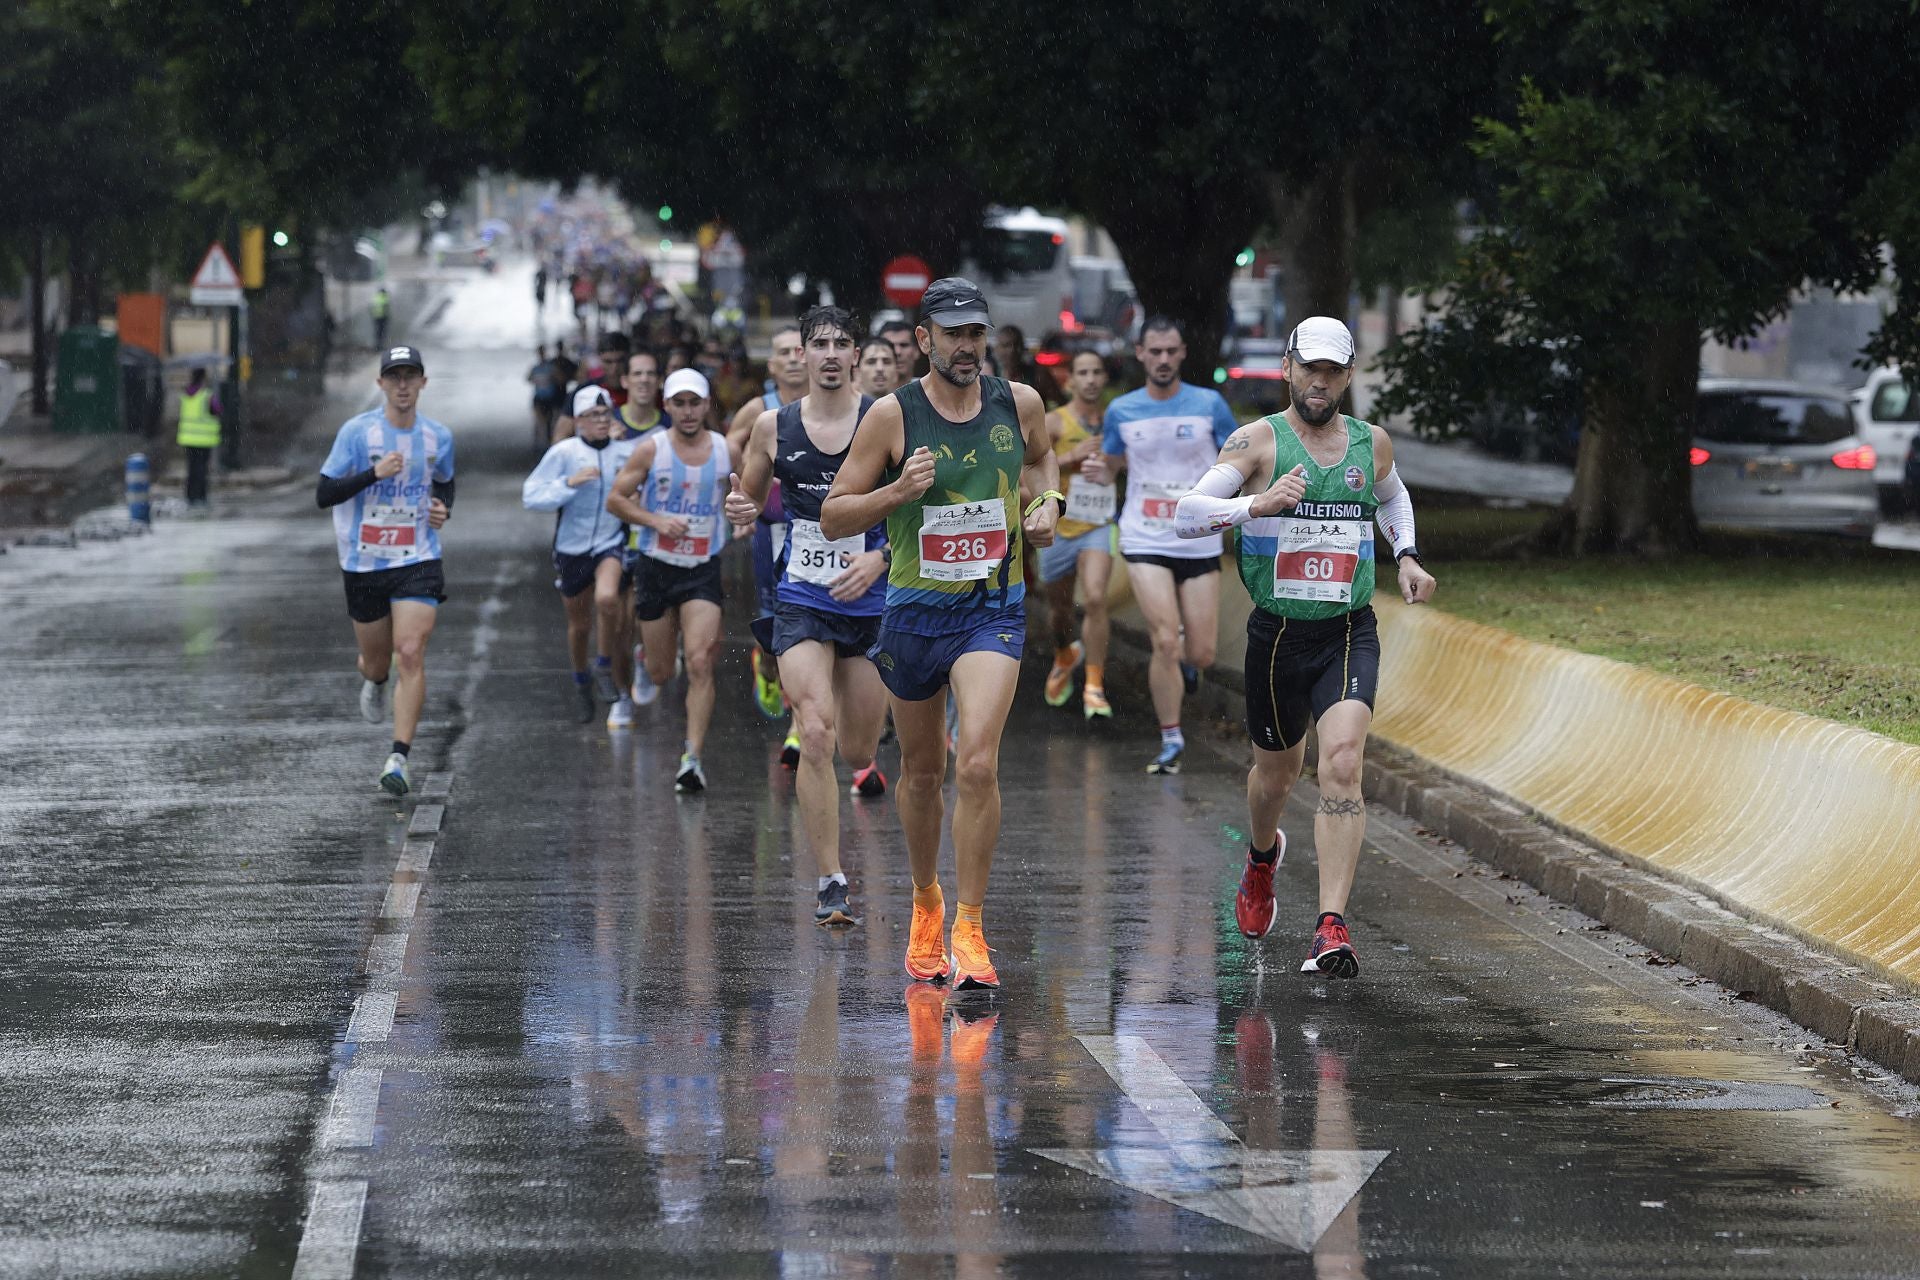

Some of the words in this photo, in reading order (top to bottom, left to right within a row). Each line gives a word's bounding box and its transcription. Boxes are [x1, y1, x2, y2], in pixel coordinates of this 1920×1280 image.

[1294, 502, 1362, 518] ATLETISMO
[378, 529, 400, 545] 27
[942, 537, 987, 562] 236
[1304, 556, 1334, 580] 60
